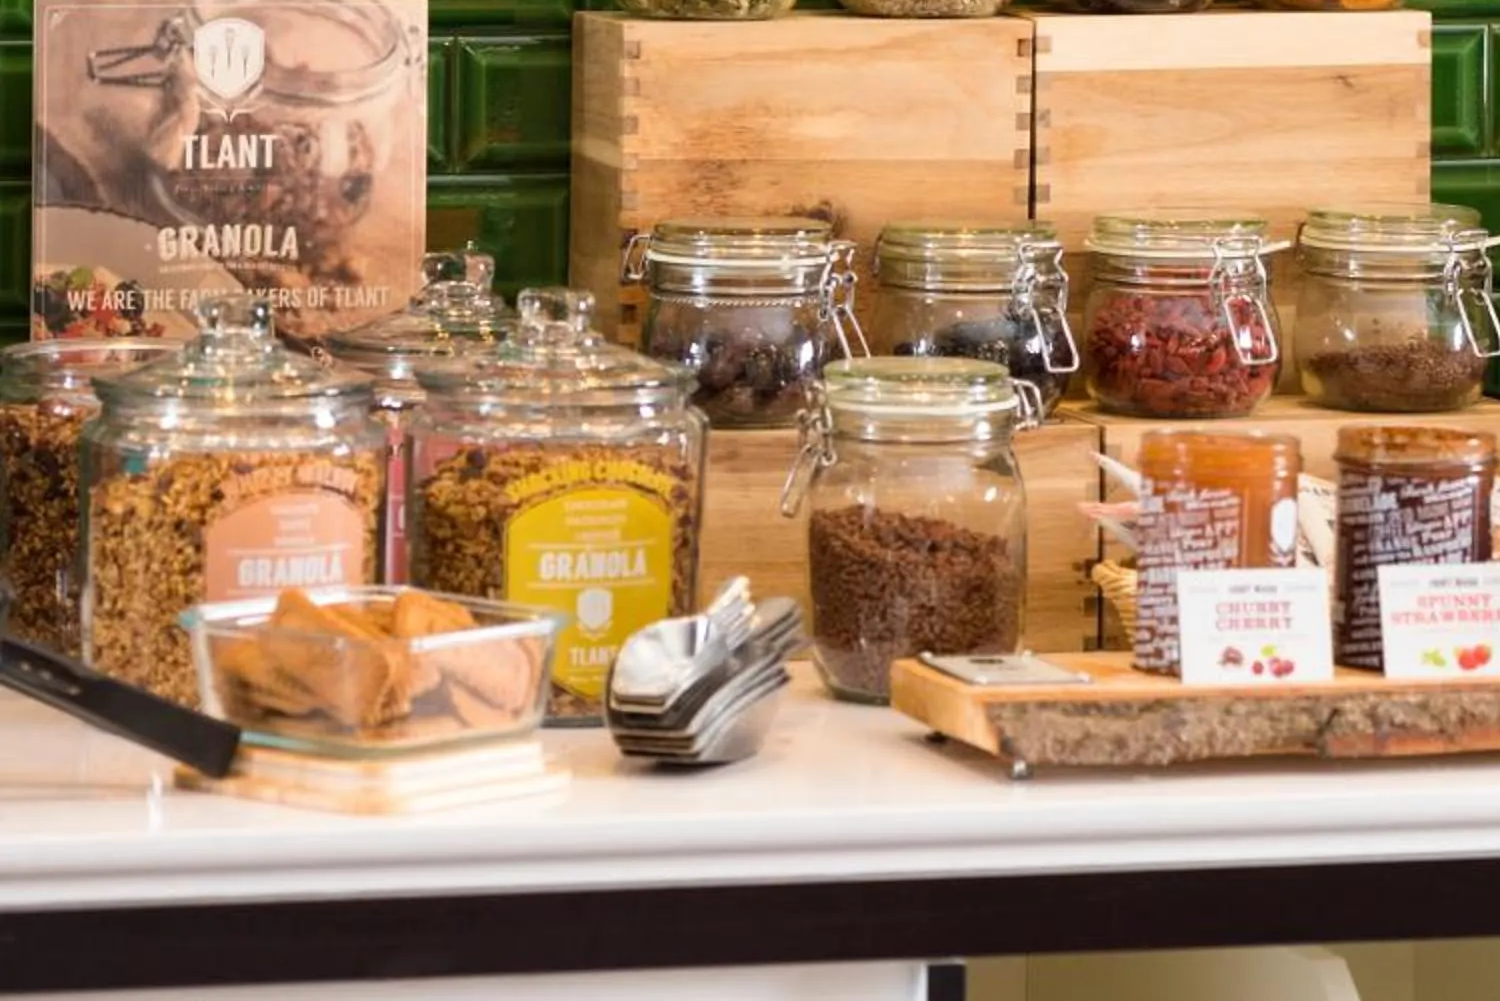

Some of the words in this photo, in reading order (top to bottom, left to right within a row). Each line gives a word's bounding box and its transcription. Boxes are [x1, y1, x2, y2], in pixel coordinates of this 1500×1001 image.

[183, 133, 279, 170] TLANT
[157, 223, 300, 262] GRANOLA
[67, 290, 97, 312] WE
[101, 289, 136, 310] ARE
[142, 288, 175, 310] THE
[180, 287, 228, 310] FA
[306, 285, 330, 308] OF
[332, 285, 391, 308] TLANT
[238, 549, 344, 587] GRANOLA
[539, 546, 648, 580] GRANOLA
